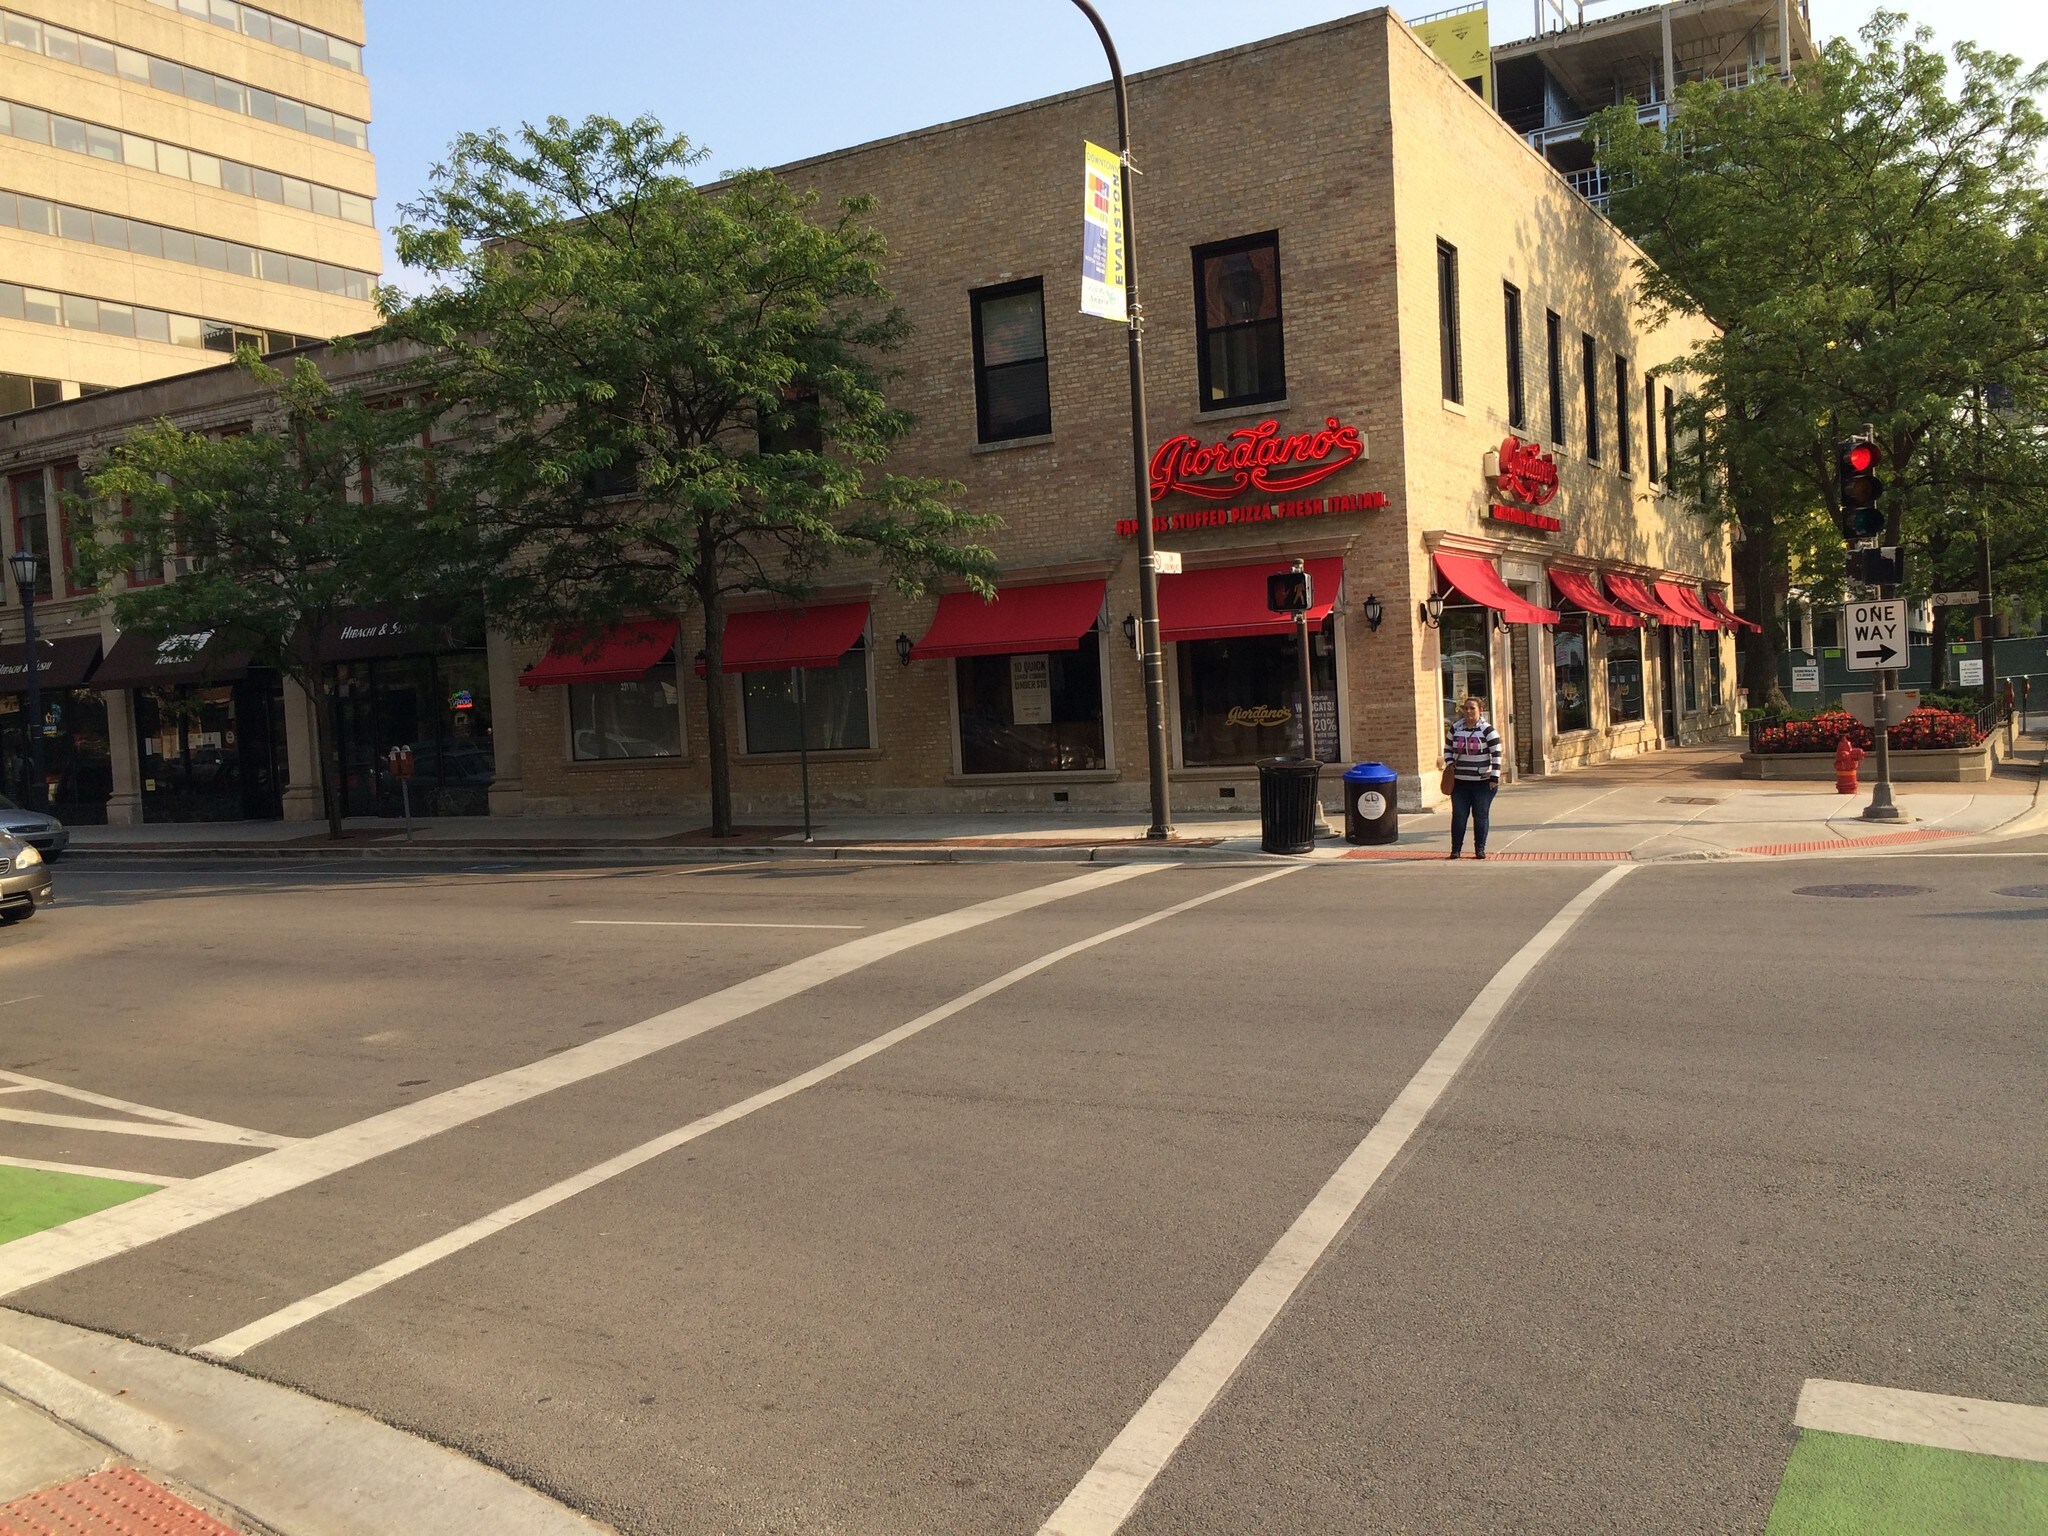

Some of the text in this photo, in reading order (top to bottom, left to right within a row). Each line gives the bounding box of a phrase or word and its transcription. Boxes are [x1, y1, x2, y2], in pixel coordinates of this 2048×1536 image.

[1087, 152, 1119, 172] DOWNTOWN
[1113, 173, 1123, 285] EVANSTON
[1150, 416, 1365, 502] Giordano's
[1171, 509, 1228, 530] STUFFED
[1278, 498, 1324, 518] FRESH
[1856, 606, 1895, 623] ONE
[341, 625, 377, 640] HIBACHI
[378, 622, 388, 636] &
[1855, 624, 1897, 641] WAY
[1023, 660, 1046, 673] QUICK
[1014, 679, 1048, 690] UNDER $10
[1226, 704, 1292, 727] Giordano's
[1314, 719, 1337, 731] 20%
